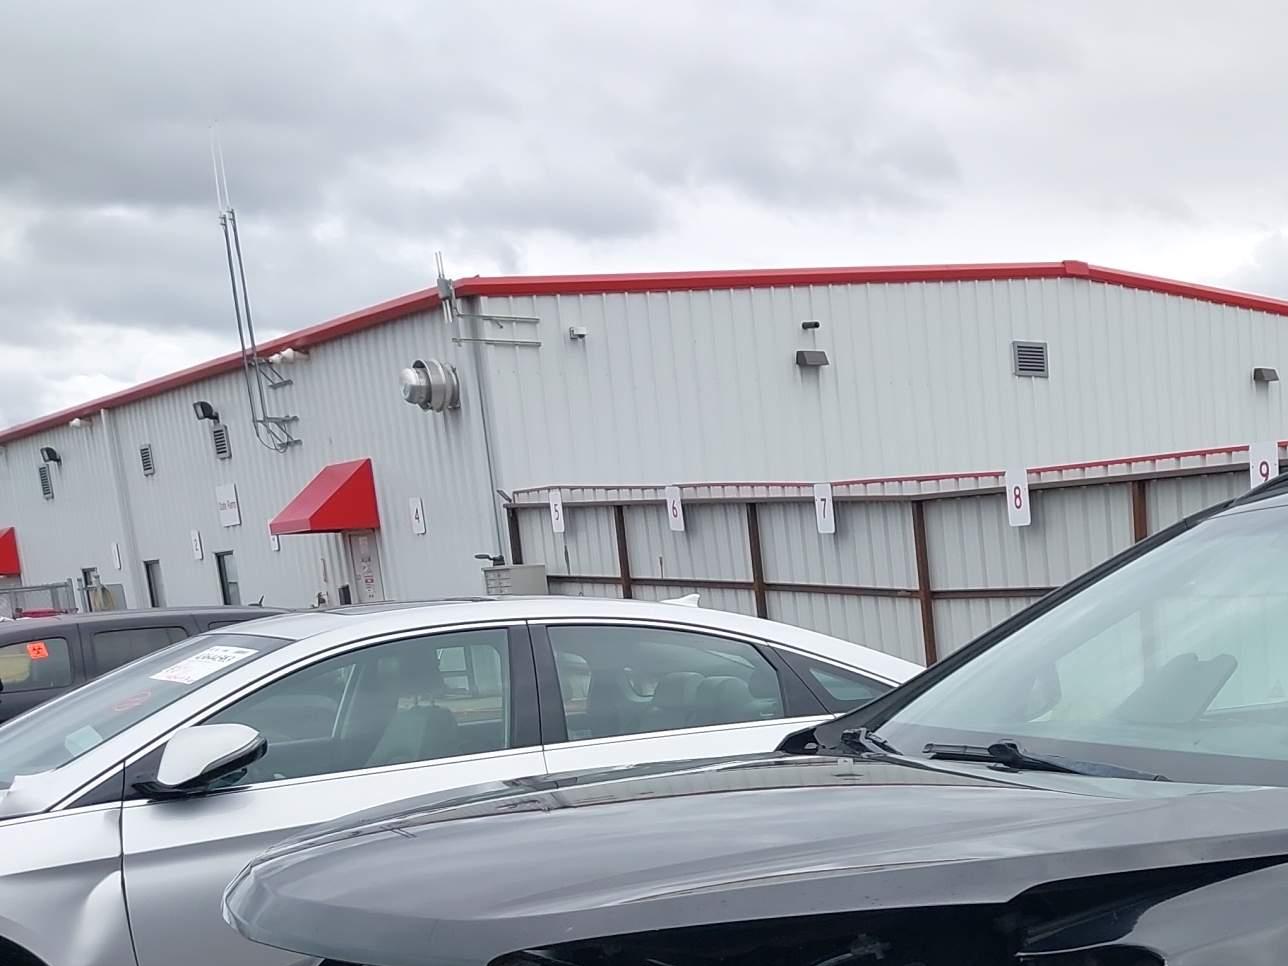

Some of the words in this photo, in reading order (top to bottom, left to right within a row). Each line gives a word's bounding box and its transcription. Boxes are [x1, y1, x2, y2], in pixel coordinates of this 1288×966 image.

[1259, 460, 1270, 482] 9
[1013, 486, 1023, 509] 8
[414, 507, 421, 523] 4
[553, 503, 560, 521] 5
[671, 499, 679, 518] 6
[820, 498, 827, 519] 7
